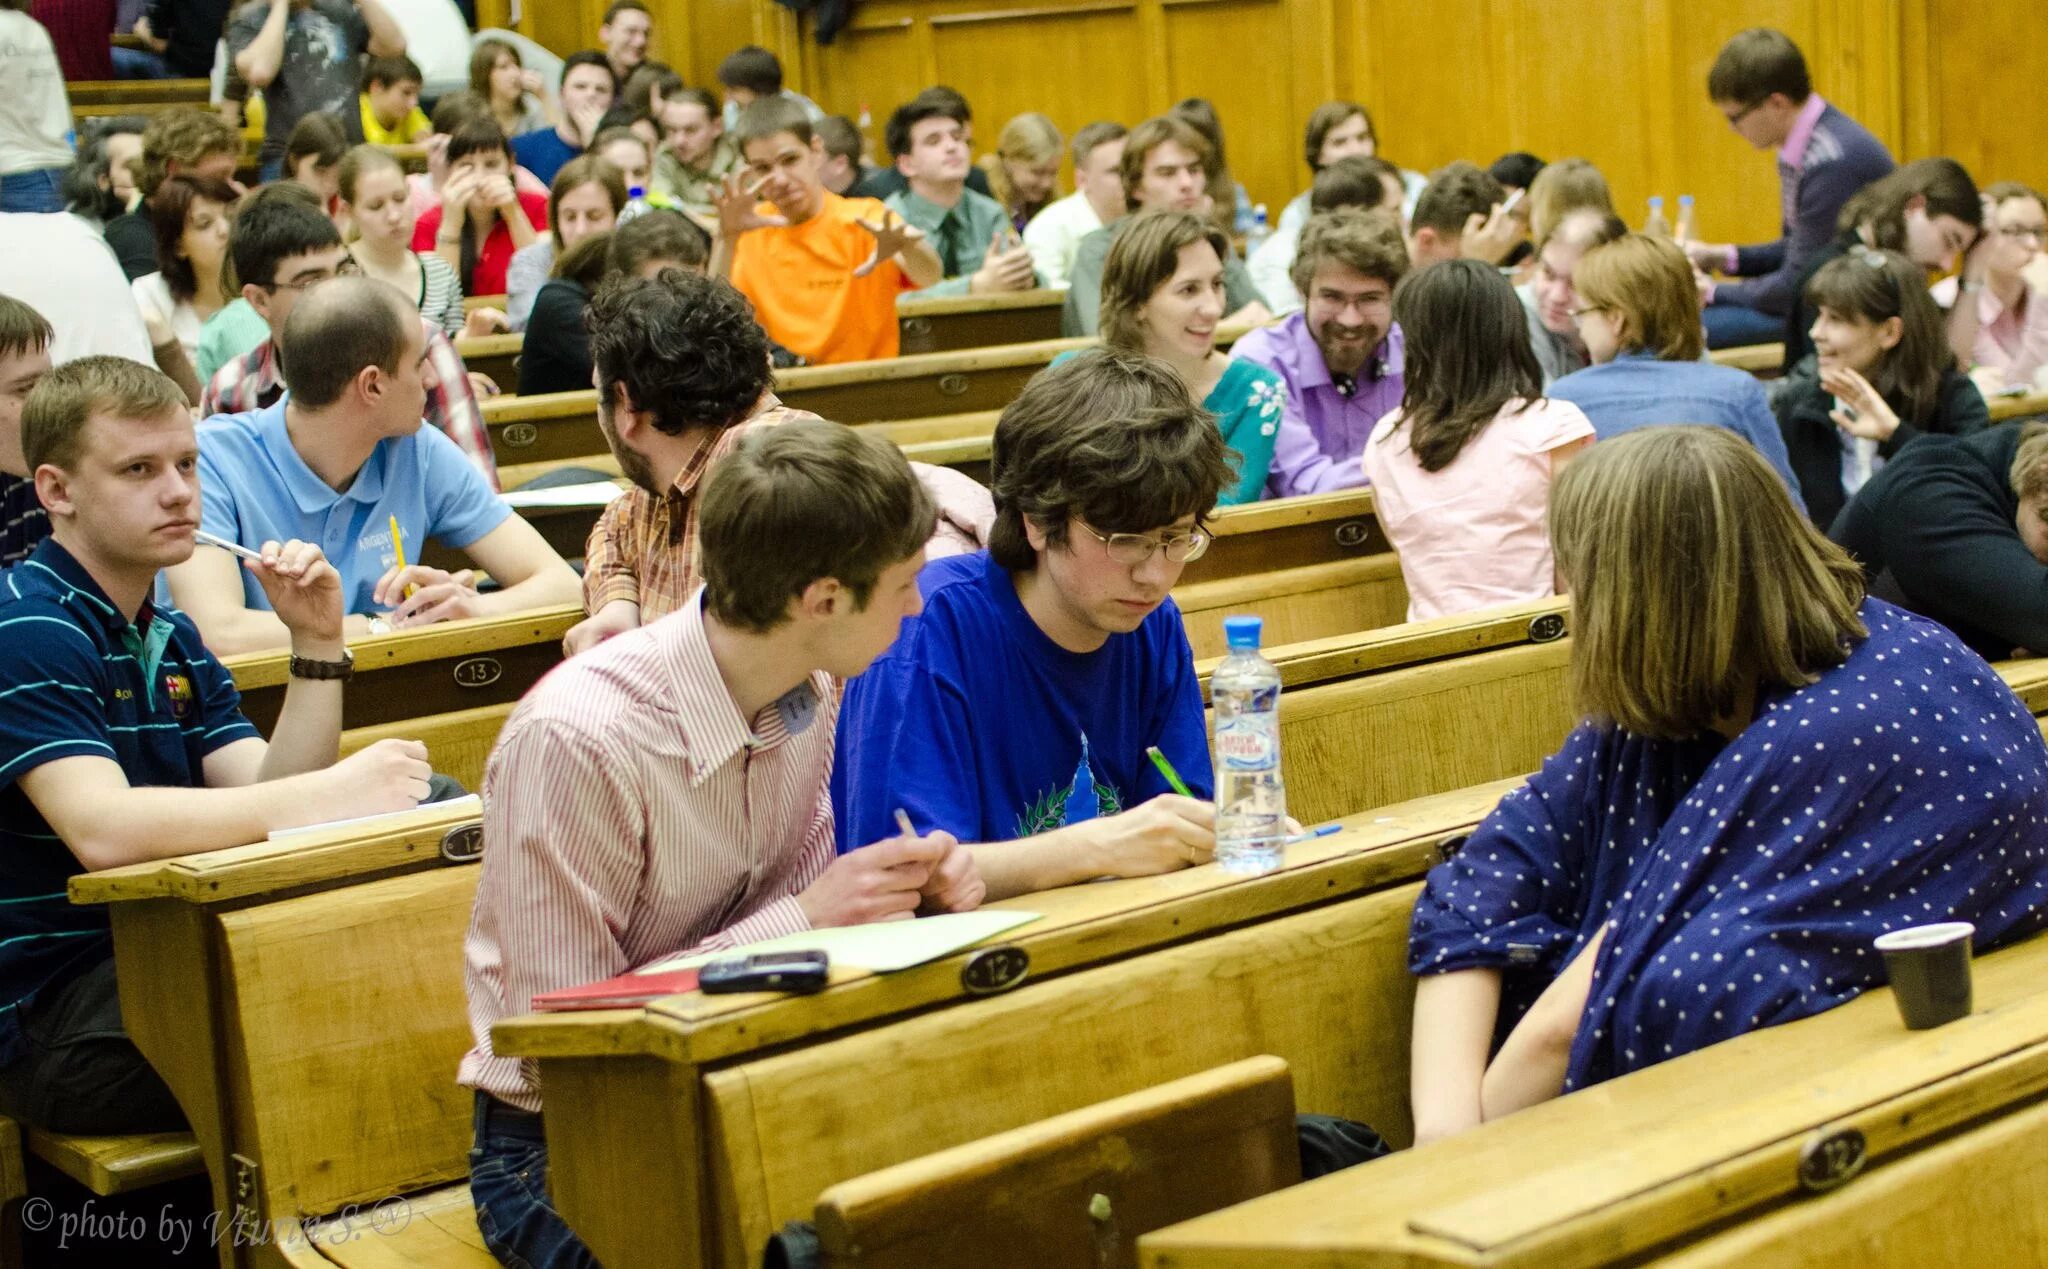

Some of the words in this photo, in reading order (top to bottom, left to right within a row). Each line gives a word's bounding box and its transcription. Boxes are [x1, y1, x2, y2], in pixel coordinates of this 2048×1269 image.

[470, 663, 487, 680] 13
[463, 830, 485, 853] 12
[986, 955, 1009, 984] 12
[1824, 1140, 1849, 1175] 12
